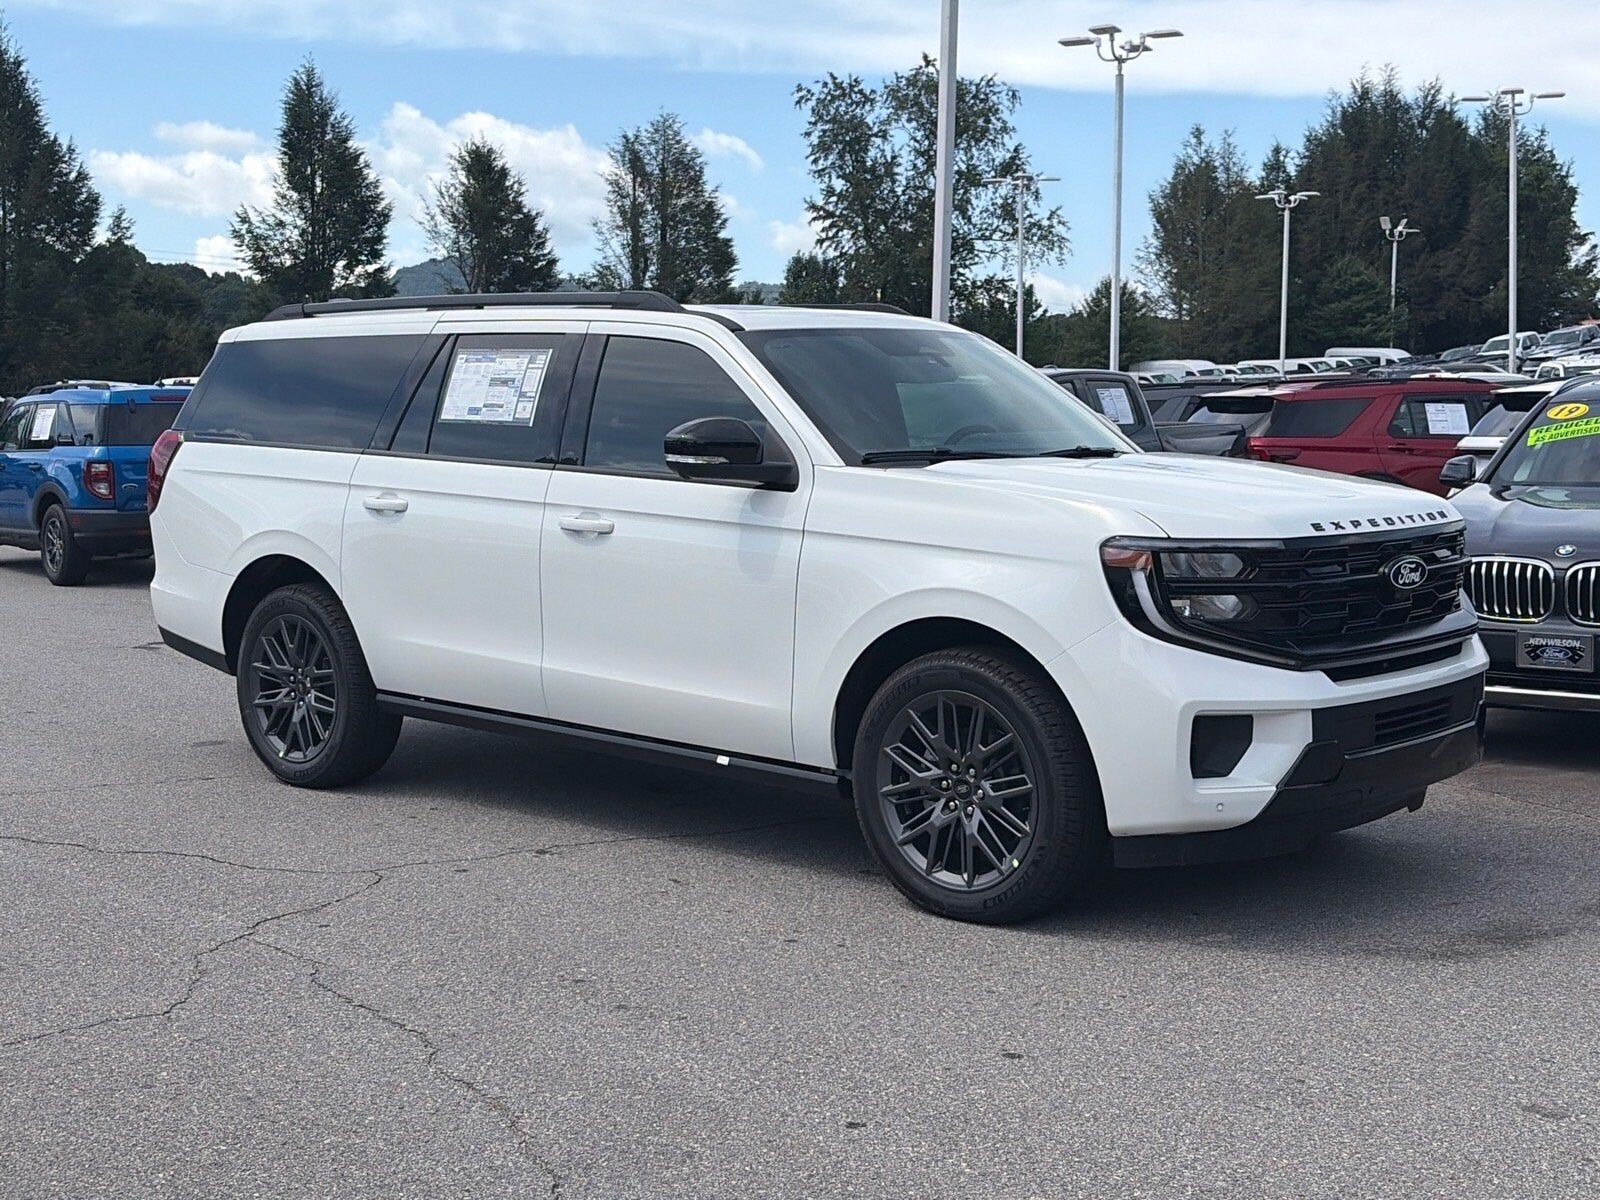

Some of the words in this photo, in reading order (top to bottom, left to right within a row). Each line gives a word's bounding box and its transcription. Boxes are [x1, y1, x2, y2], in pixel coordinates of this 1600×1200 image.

[1548, 426, 1600, 440] ADVERTISED
[1310, 510, 1448, 532] EXPEDITION
[1399, 563, 1422, 584] Ford
[1547, 638, 1580, 647] WILSON
[1543, 647, 1566, 658] Ford
